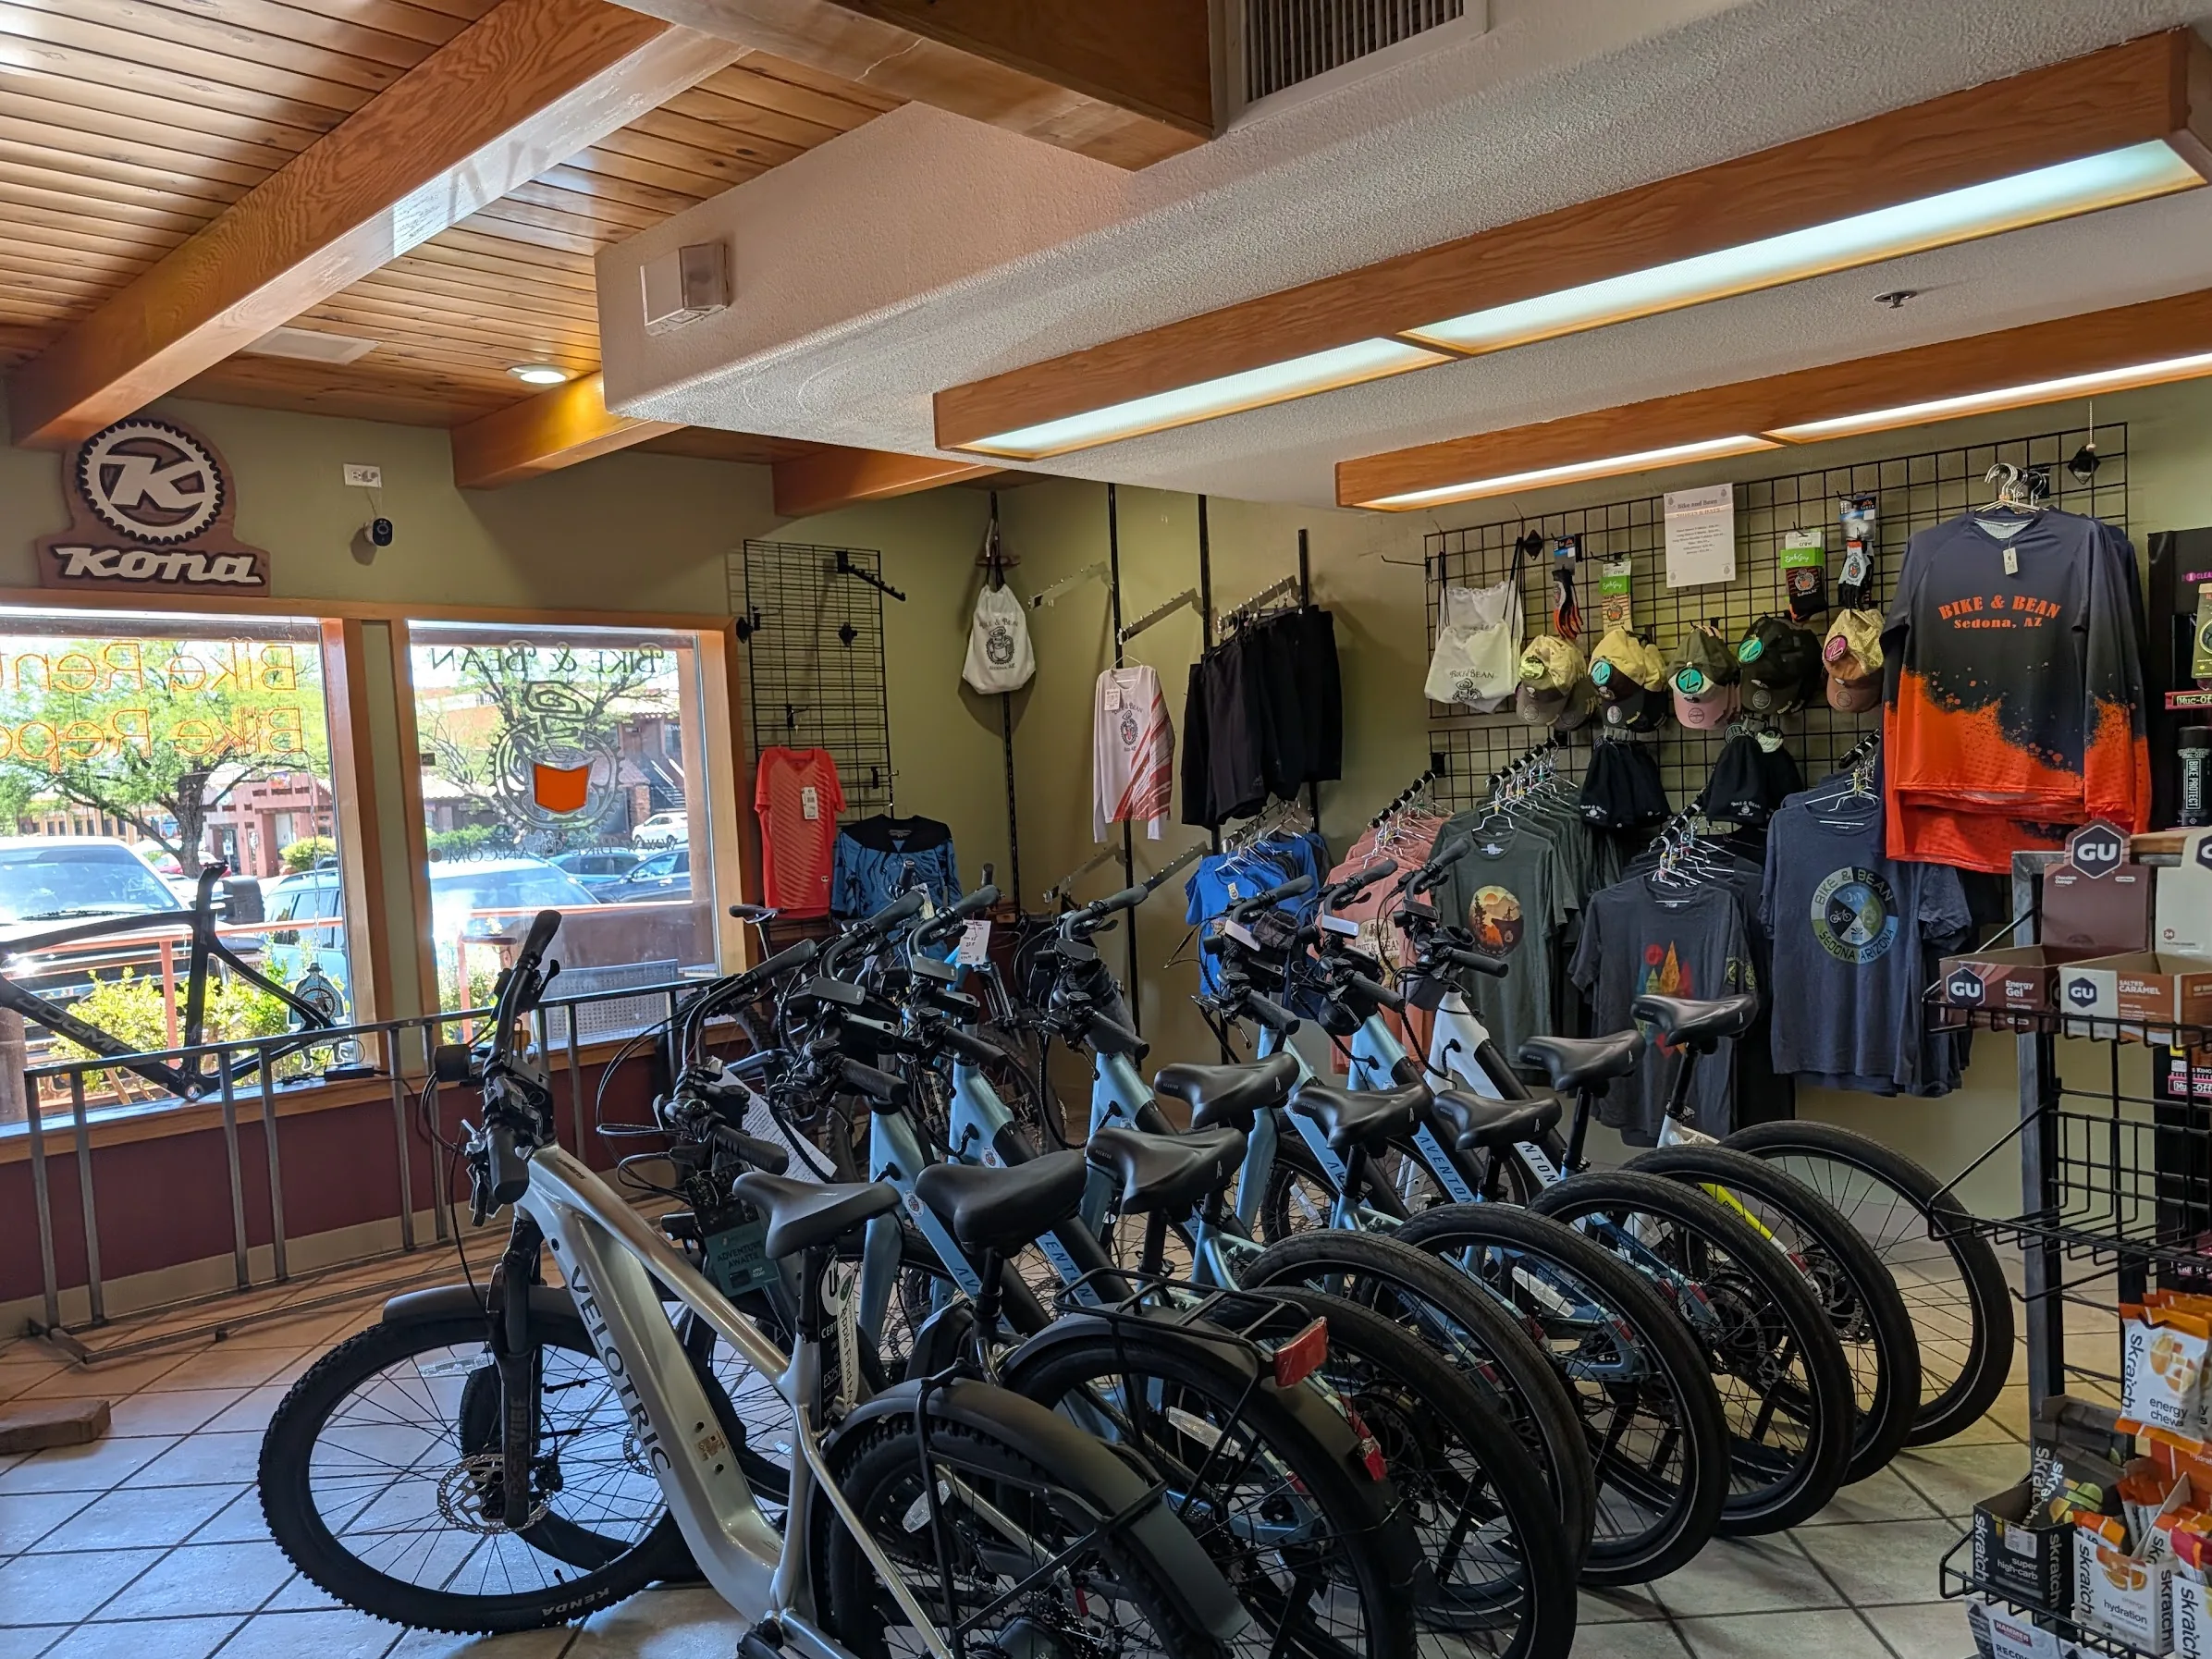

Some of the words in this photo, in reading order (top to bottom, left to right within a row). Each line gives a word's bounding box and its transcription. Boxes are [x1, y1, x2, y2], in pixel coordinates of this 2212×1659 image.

[1938, 596, 1984, 621] BIKE
[1990, 594, 2005, 609] &
[2012, 595, 2061, 620] BEAN
[1953, 618, 2017, 629] Sedona,
[2023, 617, 2043, 627] AZ
[2188, 760, 2199, 777] BIKE
[2187, 778, 2199, 807] PROTECT
[2077, 842, 2118, 861] GU
[1815, 879, 1838, 905] BIKE
[1841, 870, 1853, 880] &
[1857, 868, 1893, 902] BEAN
[1819, 931, 1857, 961] SEDONA
[1860, 928, 1894, 962] ARIZONA
[1950, 981, 1981, 998] GU
[2005, 979, 2034, 990] Energy
[2006, 987, 2024, 998] Gel
[2071, 986, 2095, 999] GU
[2119, 985, 2161, 995] CARAMEL
[2175, 1082, 2212, 1094] Mu-Off
[840, 1307, 850, 1350] Apple
[571, 1264, 671, 1475] VELOTRIC
[843, 1349, 853, 1379] Find
[2149, 1397, 2189, 1419] energy
[2150, 1409, 2184, 1428] chews
[1997, 1558, 2039, 1580] high-carb
[2011, 1557, 2038, 1571] super
[541, 1587, 610, 1617] KENDA
[2103, 1599, 2148, 1626] hydration
[1996, 1621, 2029, 1642] HAMMER
